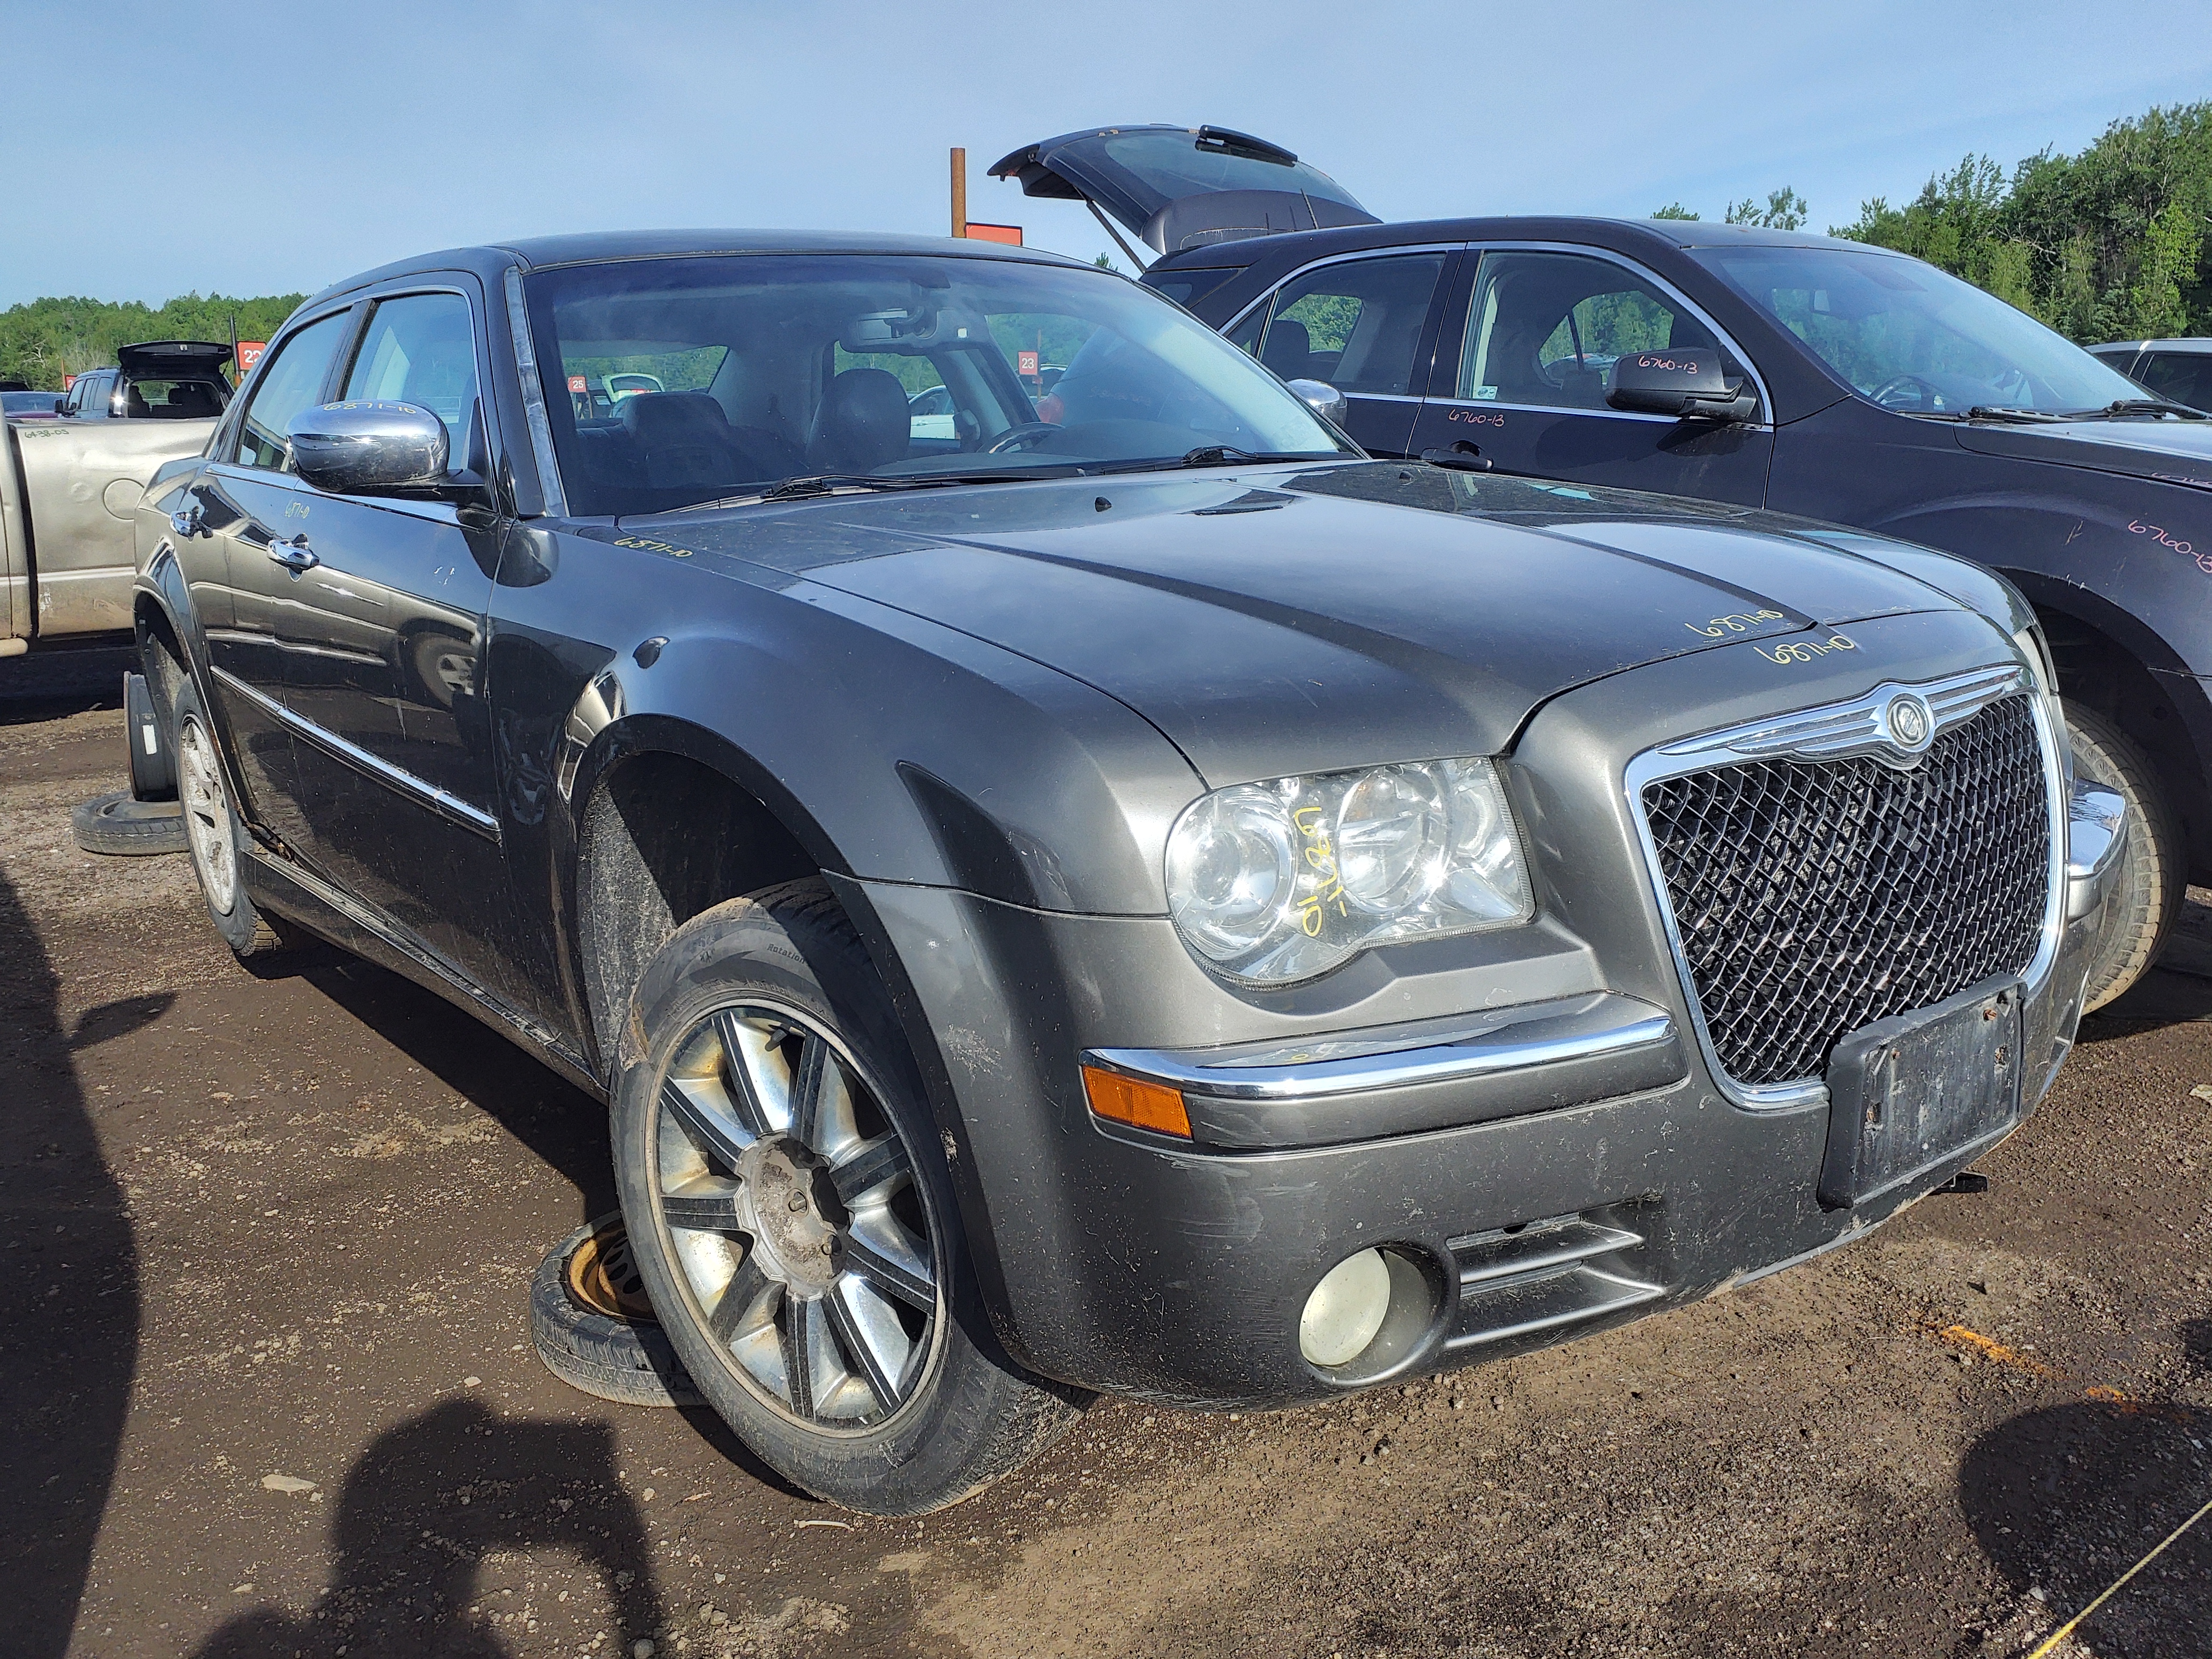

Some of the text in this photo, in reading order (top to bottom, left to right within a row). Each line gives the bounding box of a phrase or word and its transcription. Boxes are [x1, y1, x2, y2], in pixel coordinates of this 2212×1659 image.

[1021, 357, 1035, 369] 23
[1638, 355, 1698, 374] 6760-13
[572, 380, 584, 388] 25
[324, 402, 416, 414] 6871-10
[1448, 408, 1505, 427] 6760-13
[614, 536, 693, 557] 6871-10
[1684, 610, 1783, 637] 6871-10
[1753, 636, 1855, 664] 6871-10
[767, 943, 805, 965] Rotation
